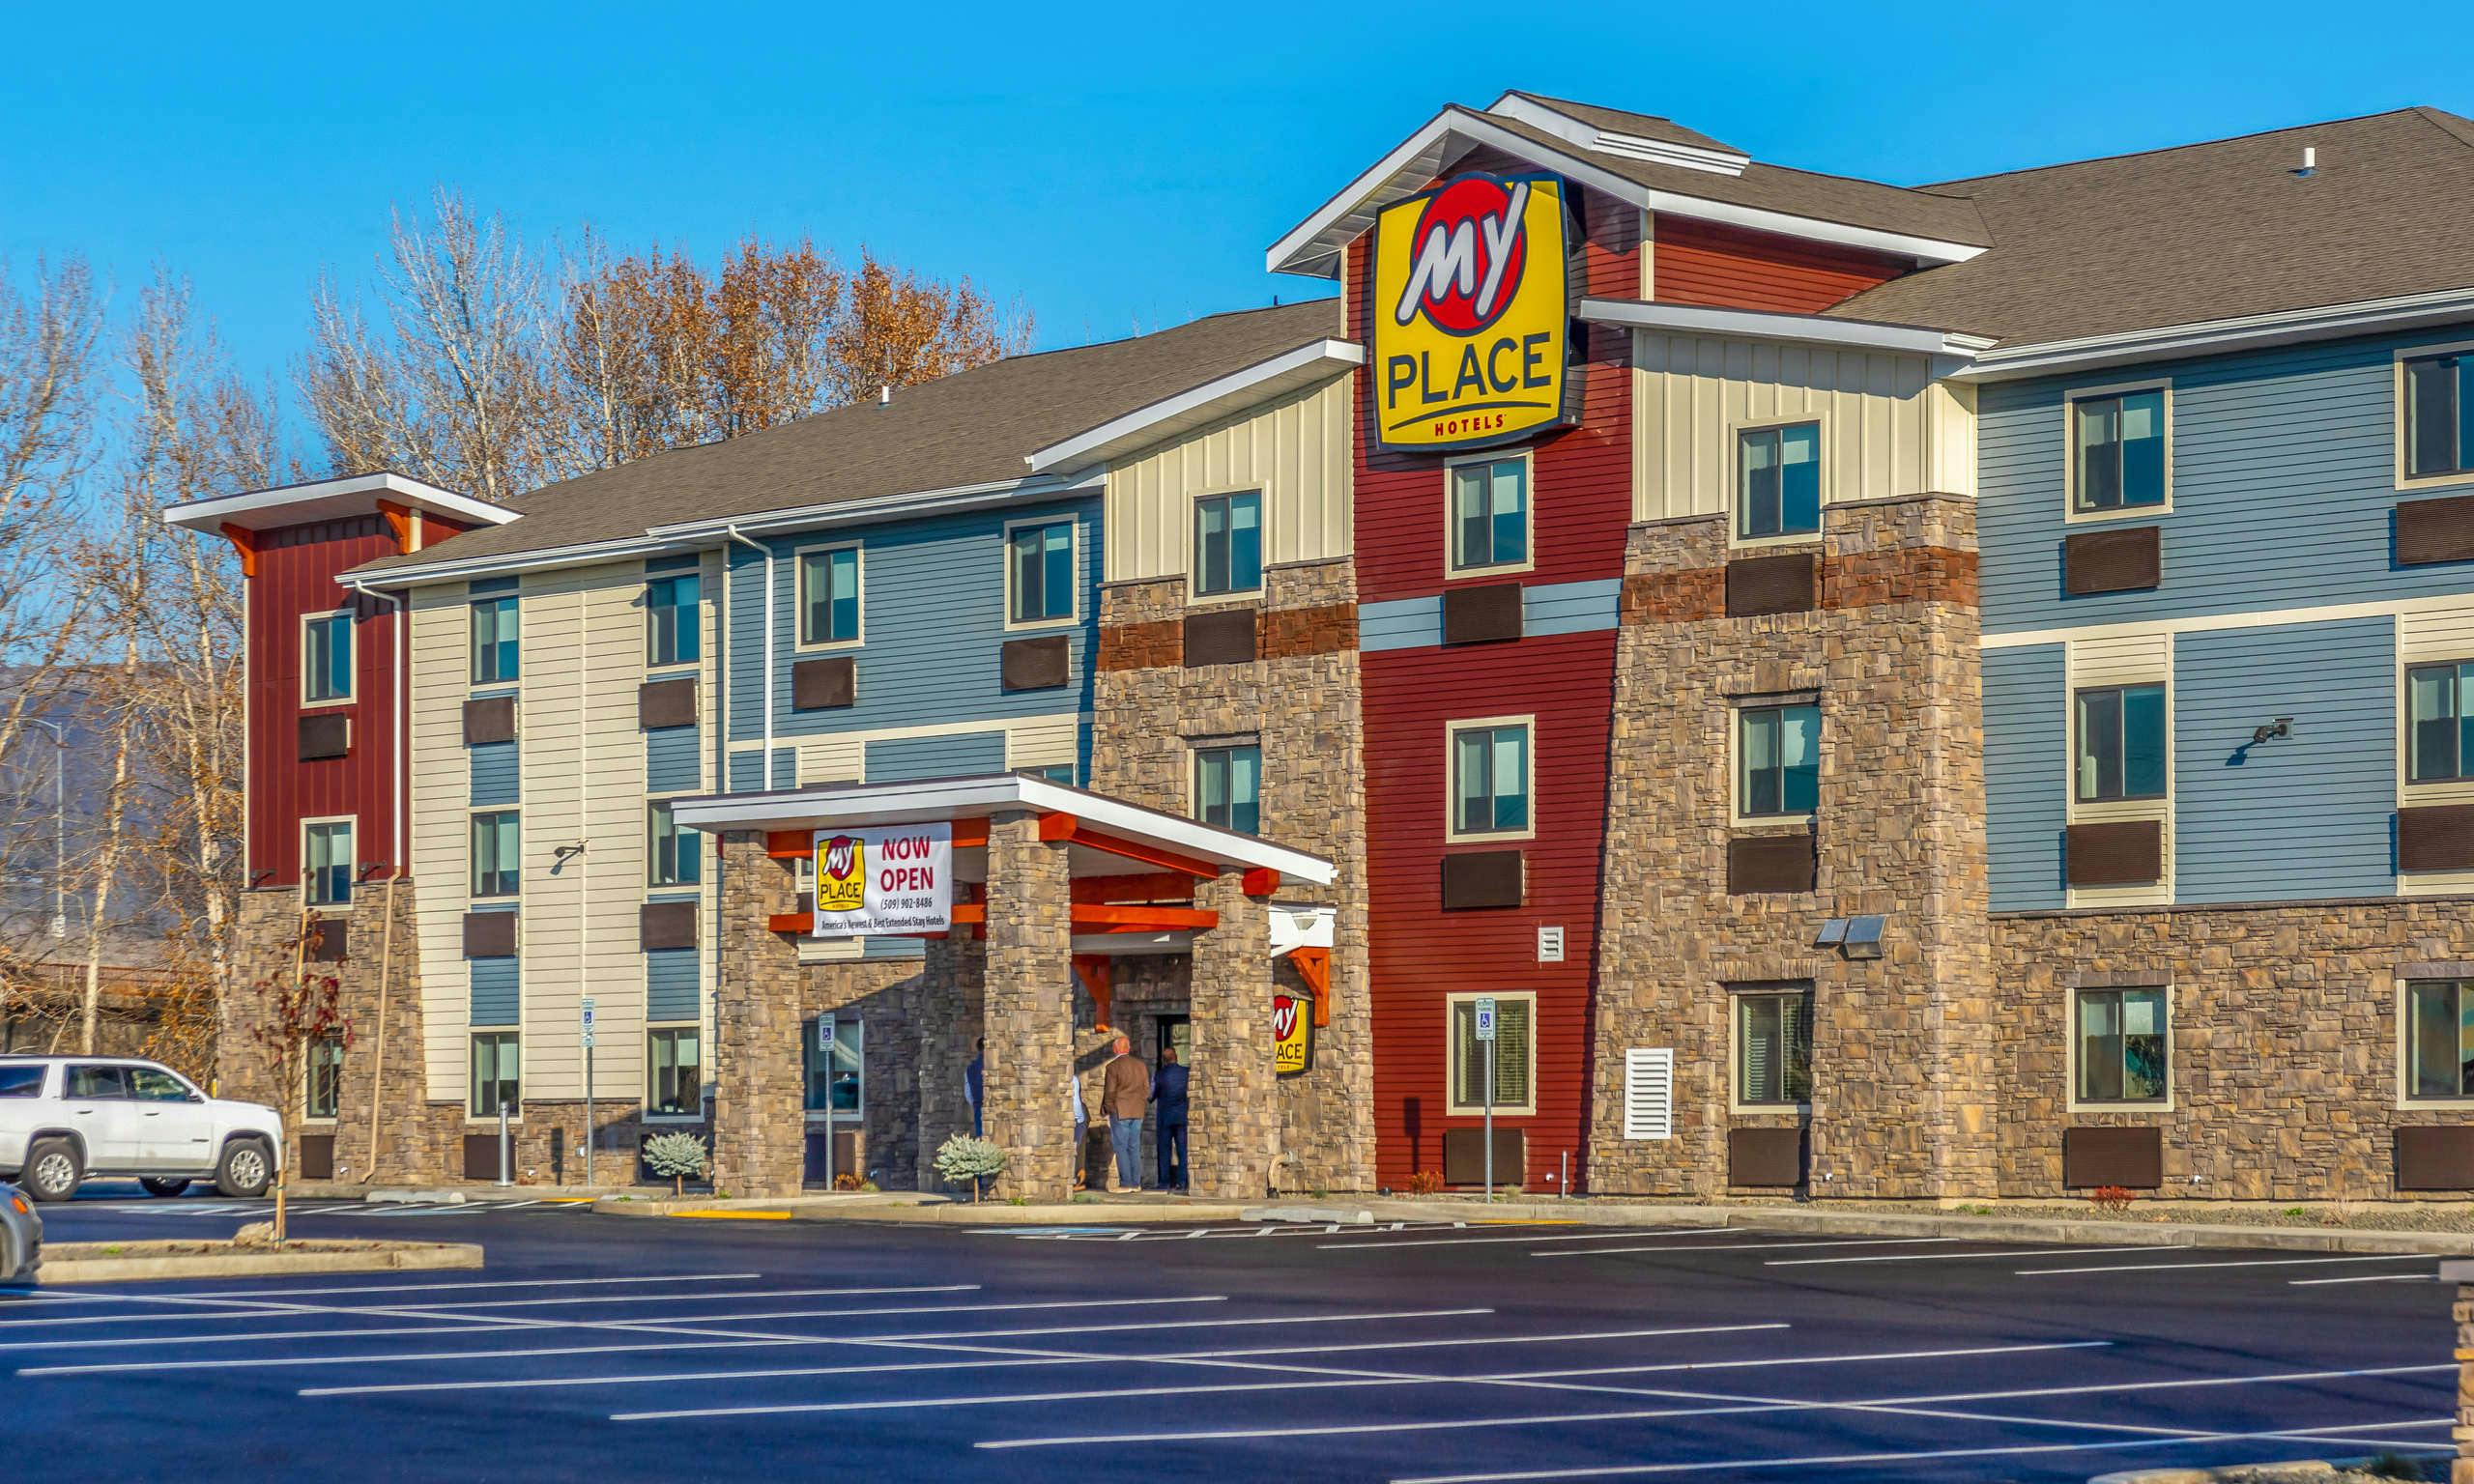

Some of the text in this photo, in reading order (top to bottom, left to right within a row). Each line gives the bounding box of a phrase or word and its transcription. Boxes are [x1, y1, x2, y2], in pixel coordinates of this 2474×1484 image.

[1388, 330, 1551, 410] PLACE
[1435, 414, 1504, 437] HOTELS
[881, 835, 931, 861] NOW
[880, 867, 934, 892] OPEN
[820, 882, 861, 899] PLACE
[880, 899, 899, 910] (509)
[885, 917, 911, 928] Extended
[912, 916, 926, 928] Stay
[926, 915, 944, 926] Hotels
[1277, 1043, 1303, 1060] ACE
